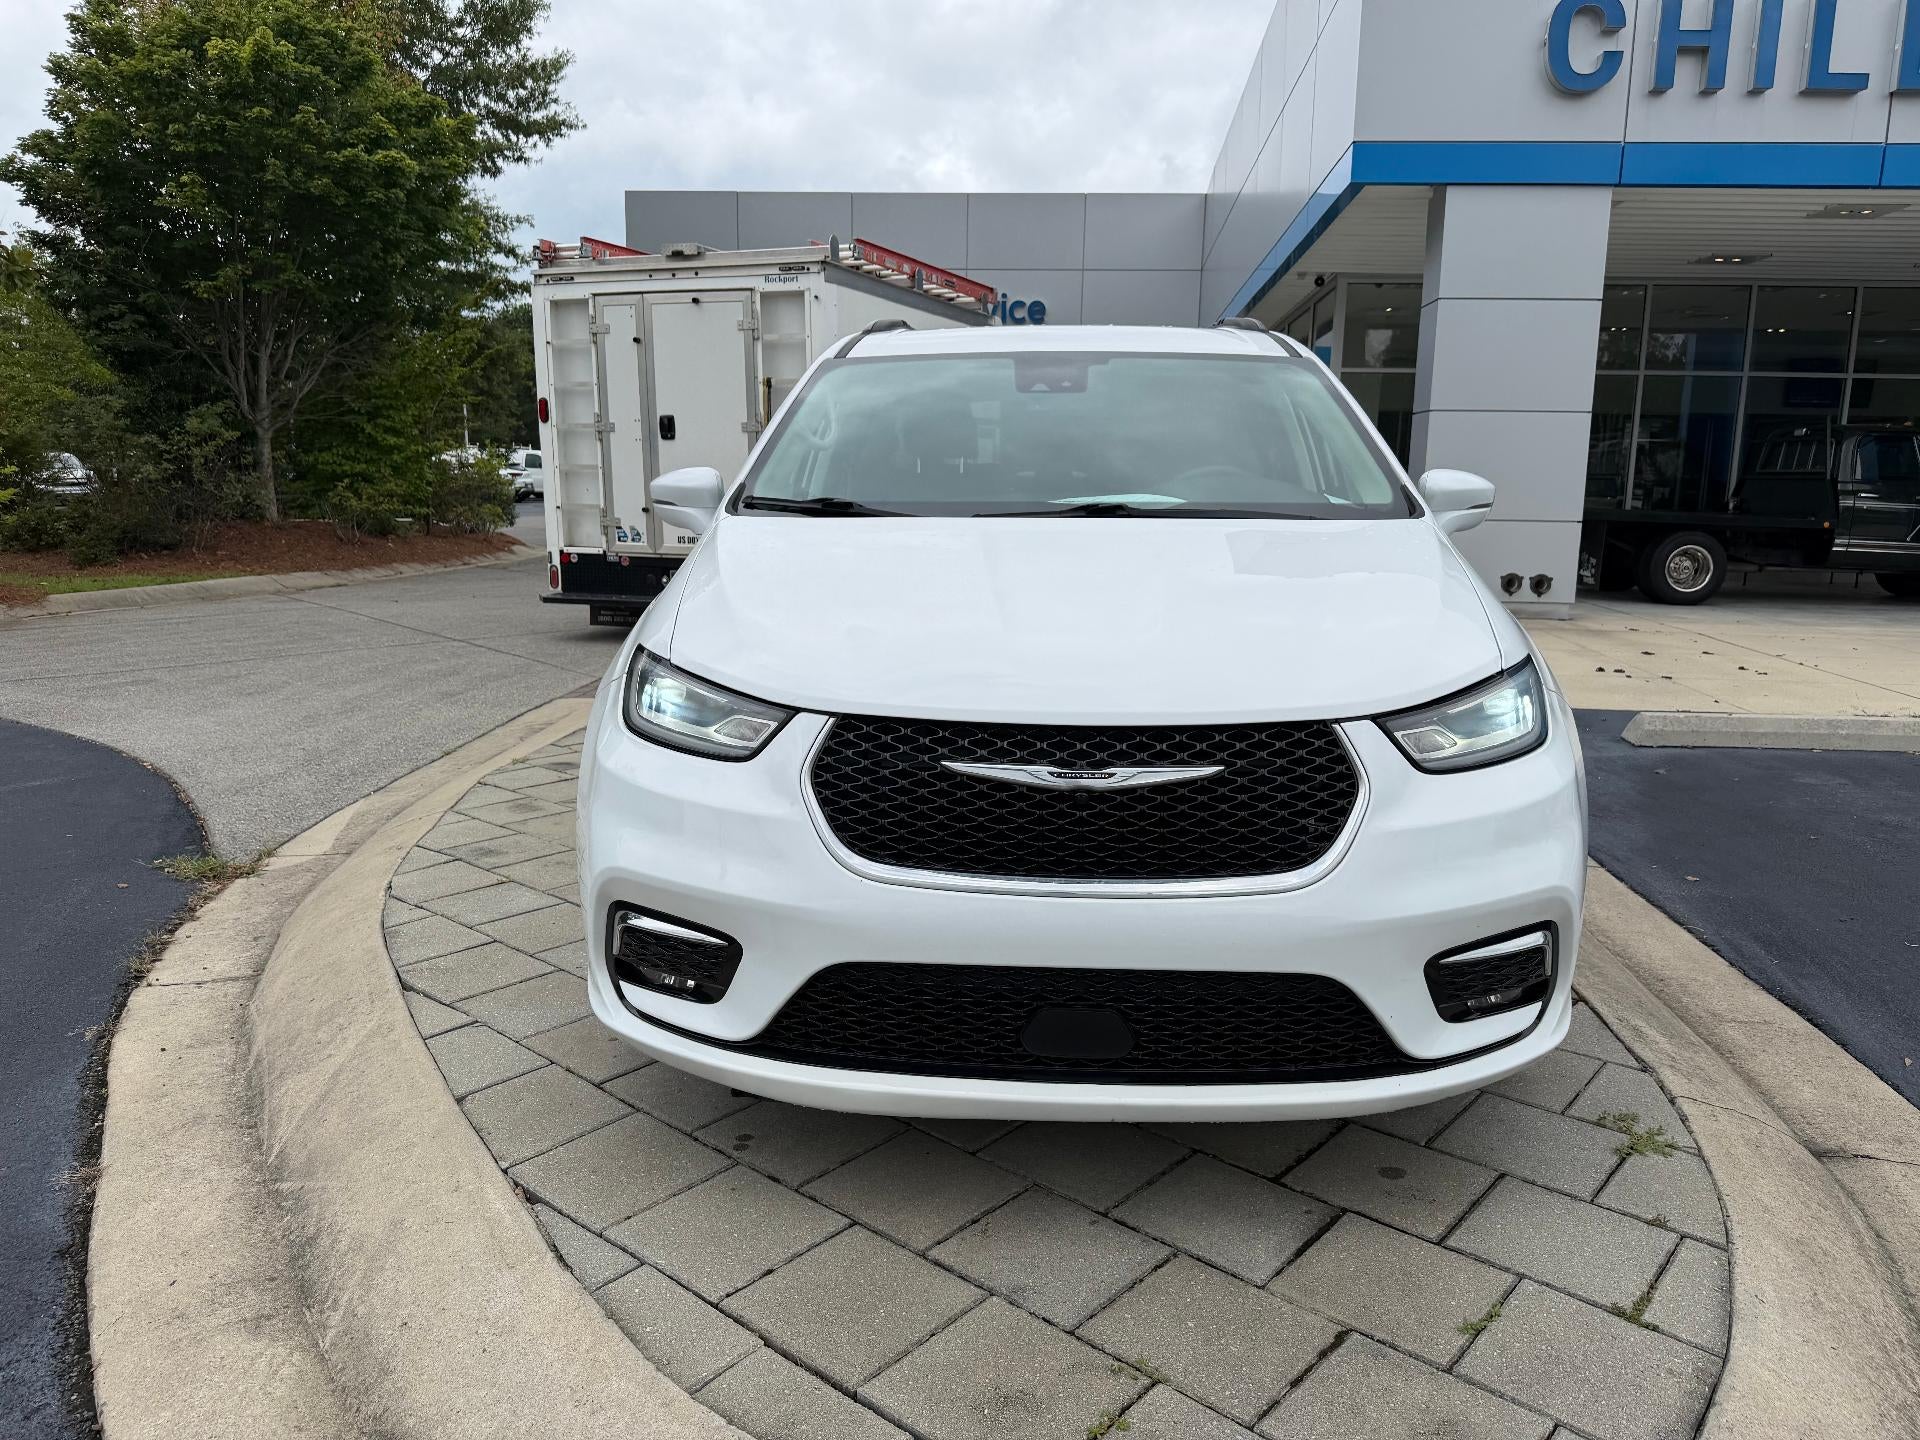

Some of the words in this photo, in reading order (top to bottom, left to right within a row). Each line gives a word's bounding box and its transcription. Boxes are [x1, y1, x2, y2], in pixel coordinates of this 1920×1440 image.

[1544, 0, 1920, 93] CHIL
[764, 274, 799, 284] Rockport
[677, 535, 686, 544] US
